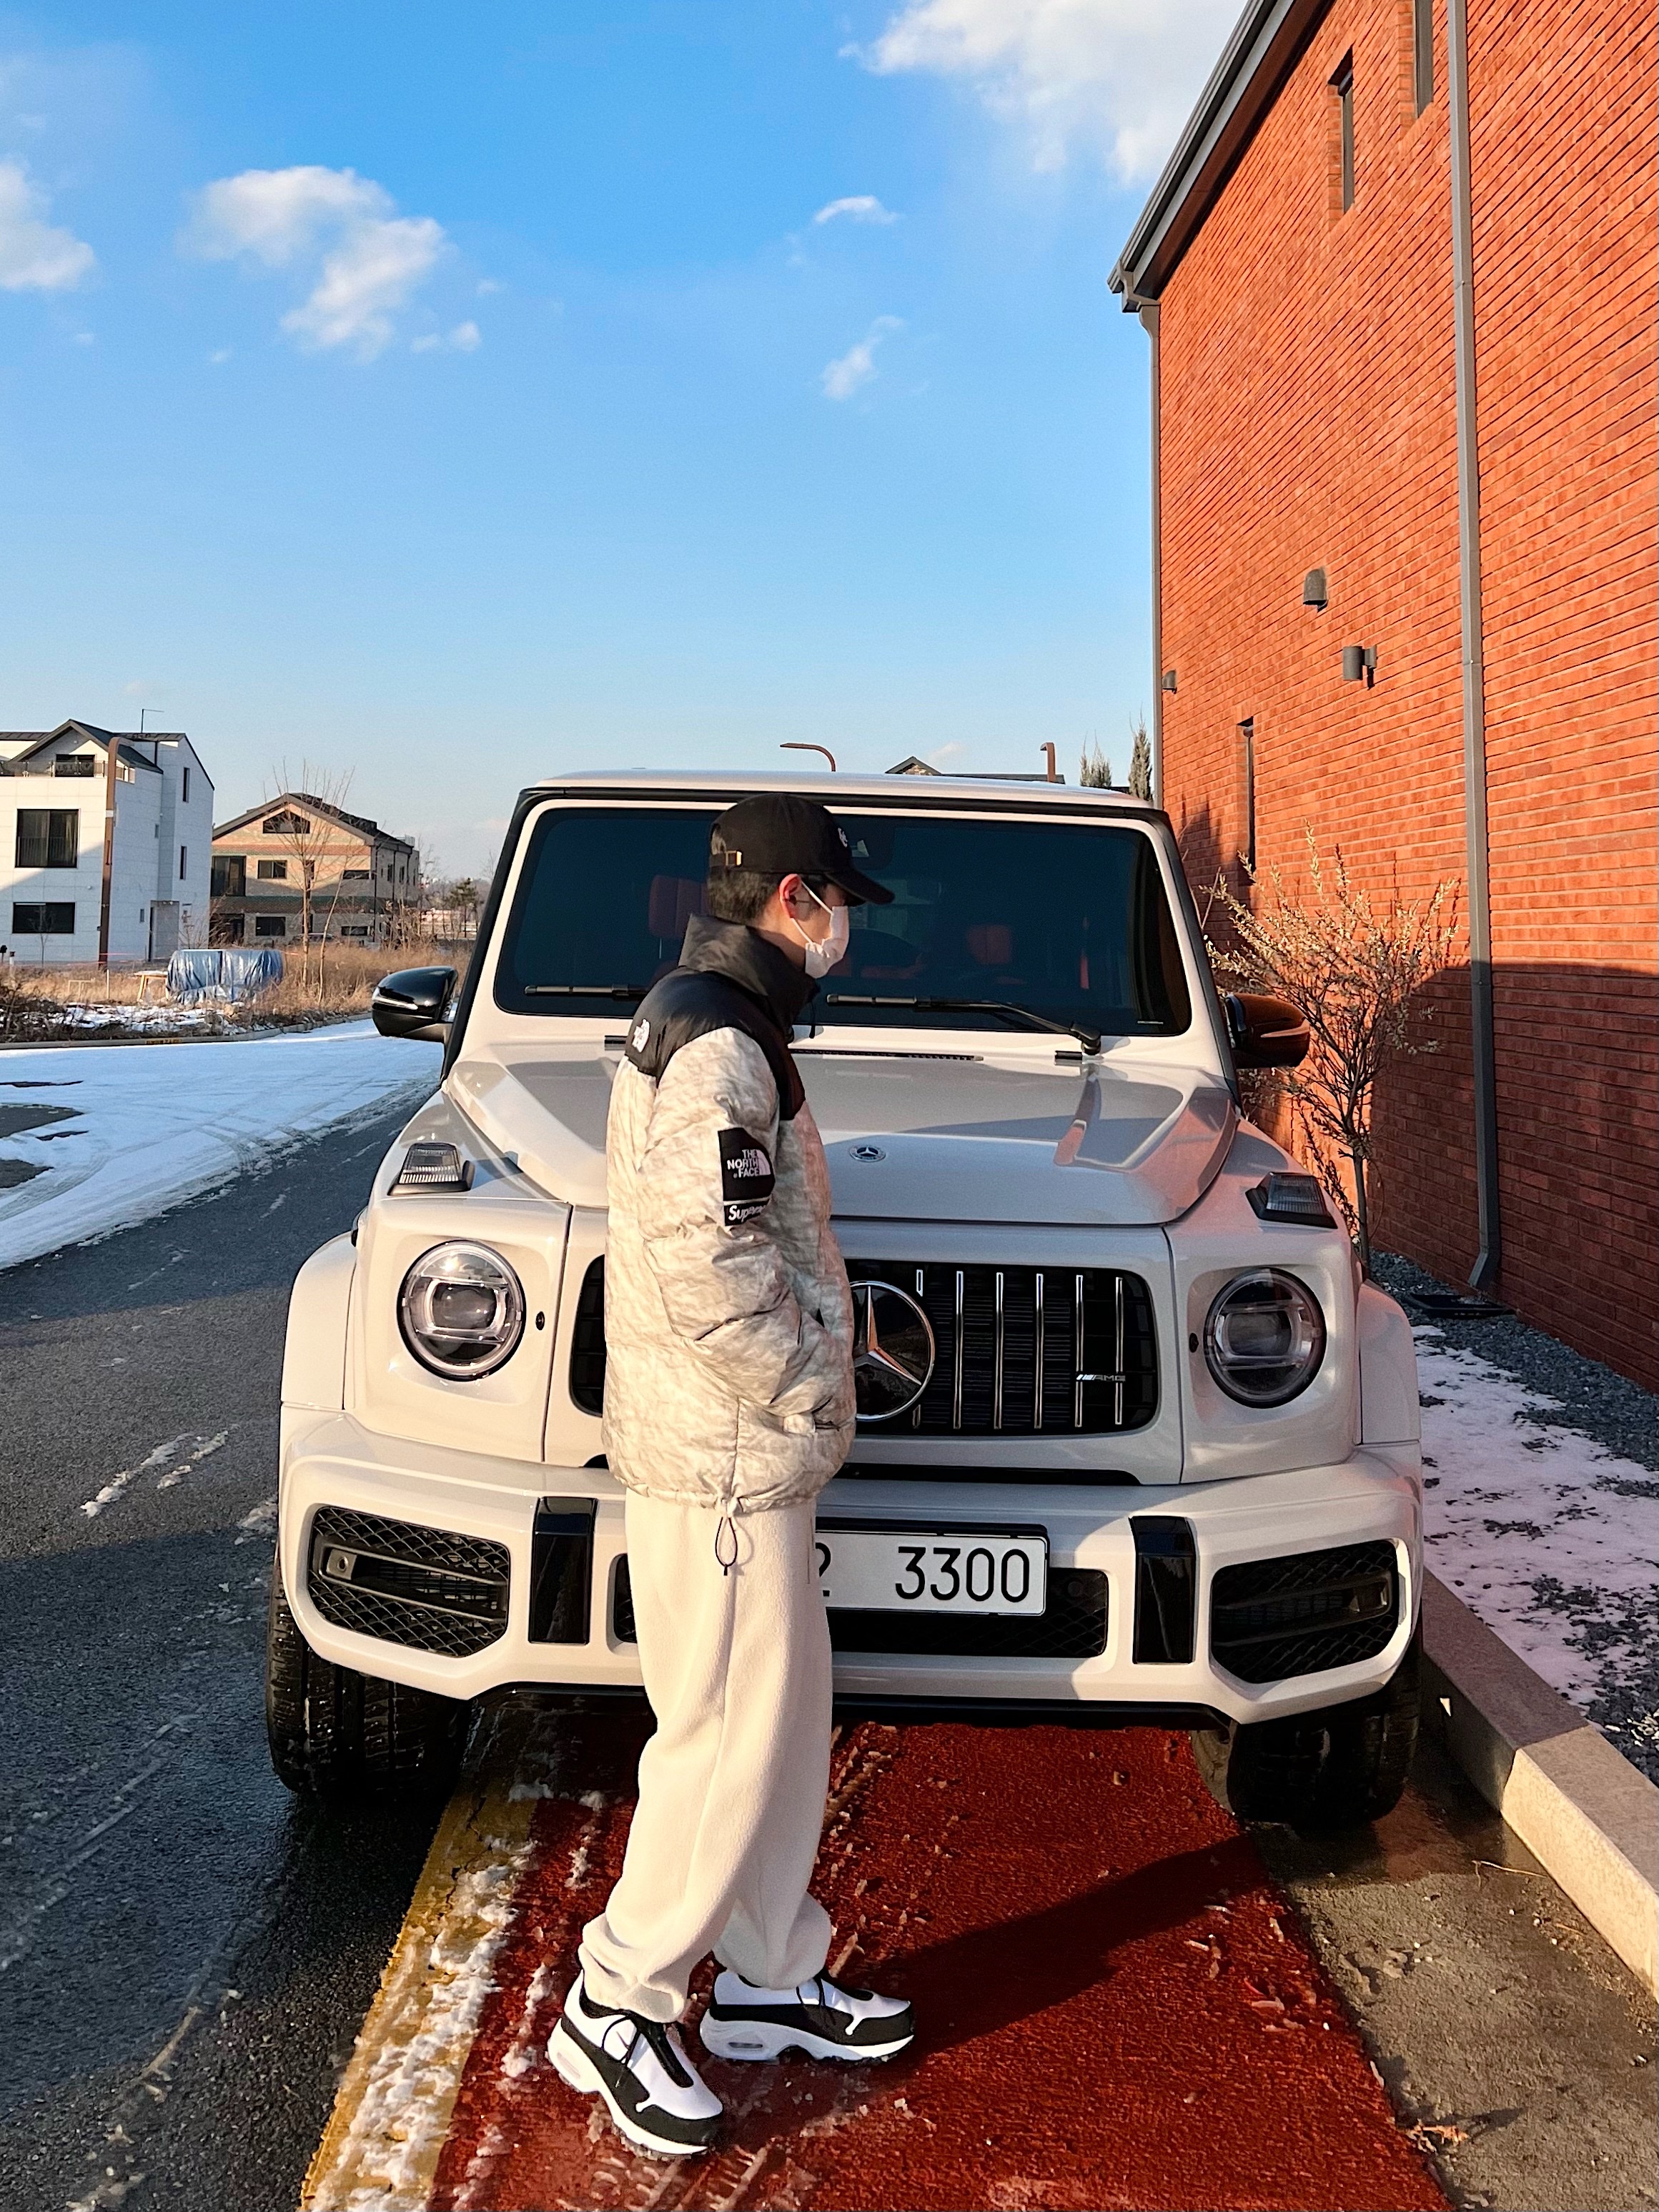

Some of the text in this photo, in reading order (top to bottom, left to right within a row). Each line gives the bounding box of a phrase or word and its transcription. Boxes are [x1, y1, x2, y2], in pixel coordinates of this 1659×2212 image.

[742, 1149, 758, 1159] THE
[727, 1159, 758, 1170] NORTH
[738, 1168, 759, 1178] FACE
[896, 1547, 1030, 1602] 3300
